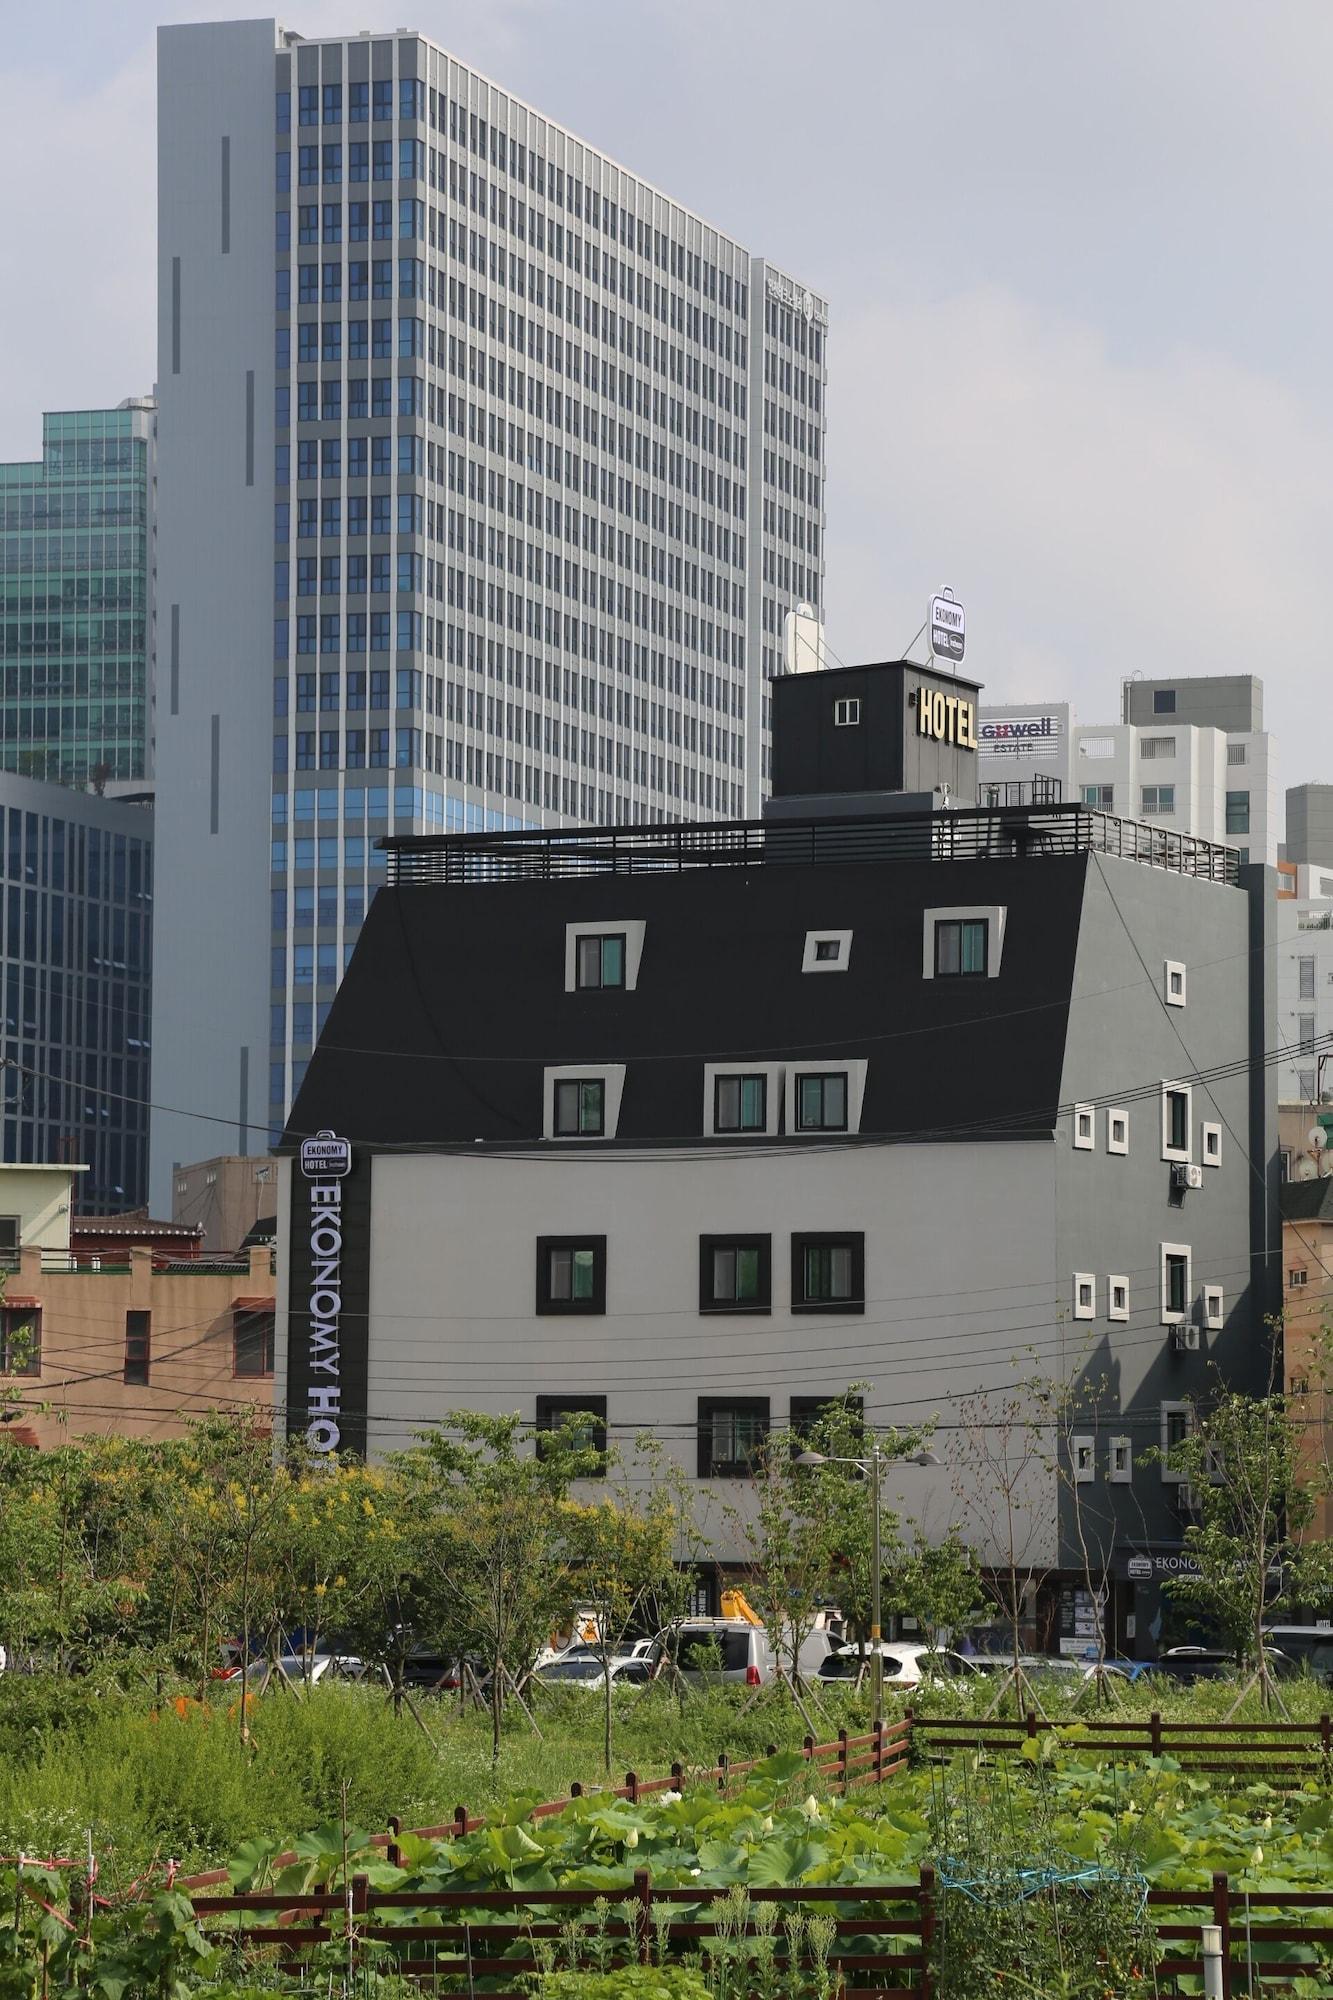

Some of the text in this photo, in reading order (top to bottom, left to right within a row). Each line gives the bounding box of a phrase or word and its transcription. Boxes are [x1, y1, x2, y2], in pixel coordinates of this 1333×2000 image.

[935, 607, 962, 627] EKONOMY
[932, 629, 949, 648] HOTEL
[919, 687, 978, 750] HOTEL
[993, 743, 1034, 753] ESTATE
[307, 1146, 342, 1155] EKONOMY
[304, 1160, 328, 1170] HOTEL
[310, 1186, 342, 1375] EKONOMY
[306, 1386, 341, 1466] HO
[1156, 1557, 1202, 1569] EKONO
